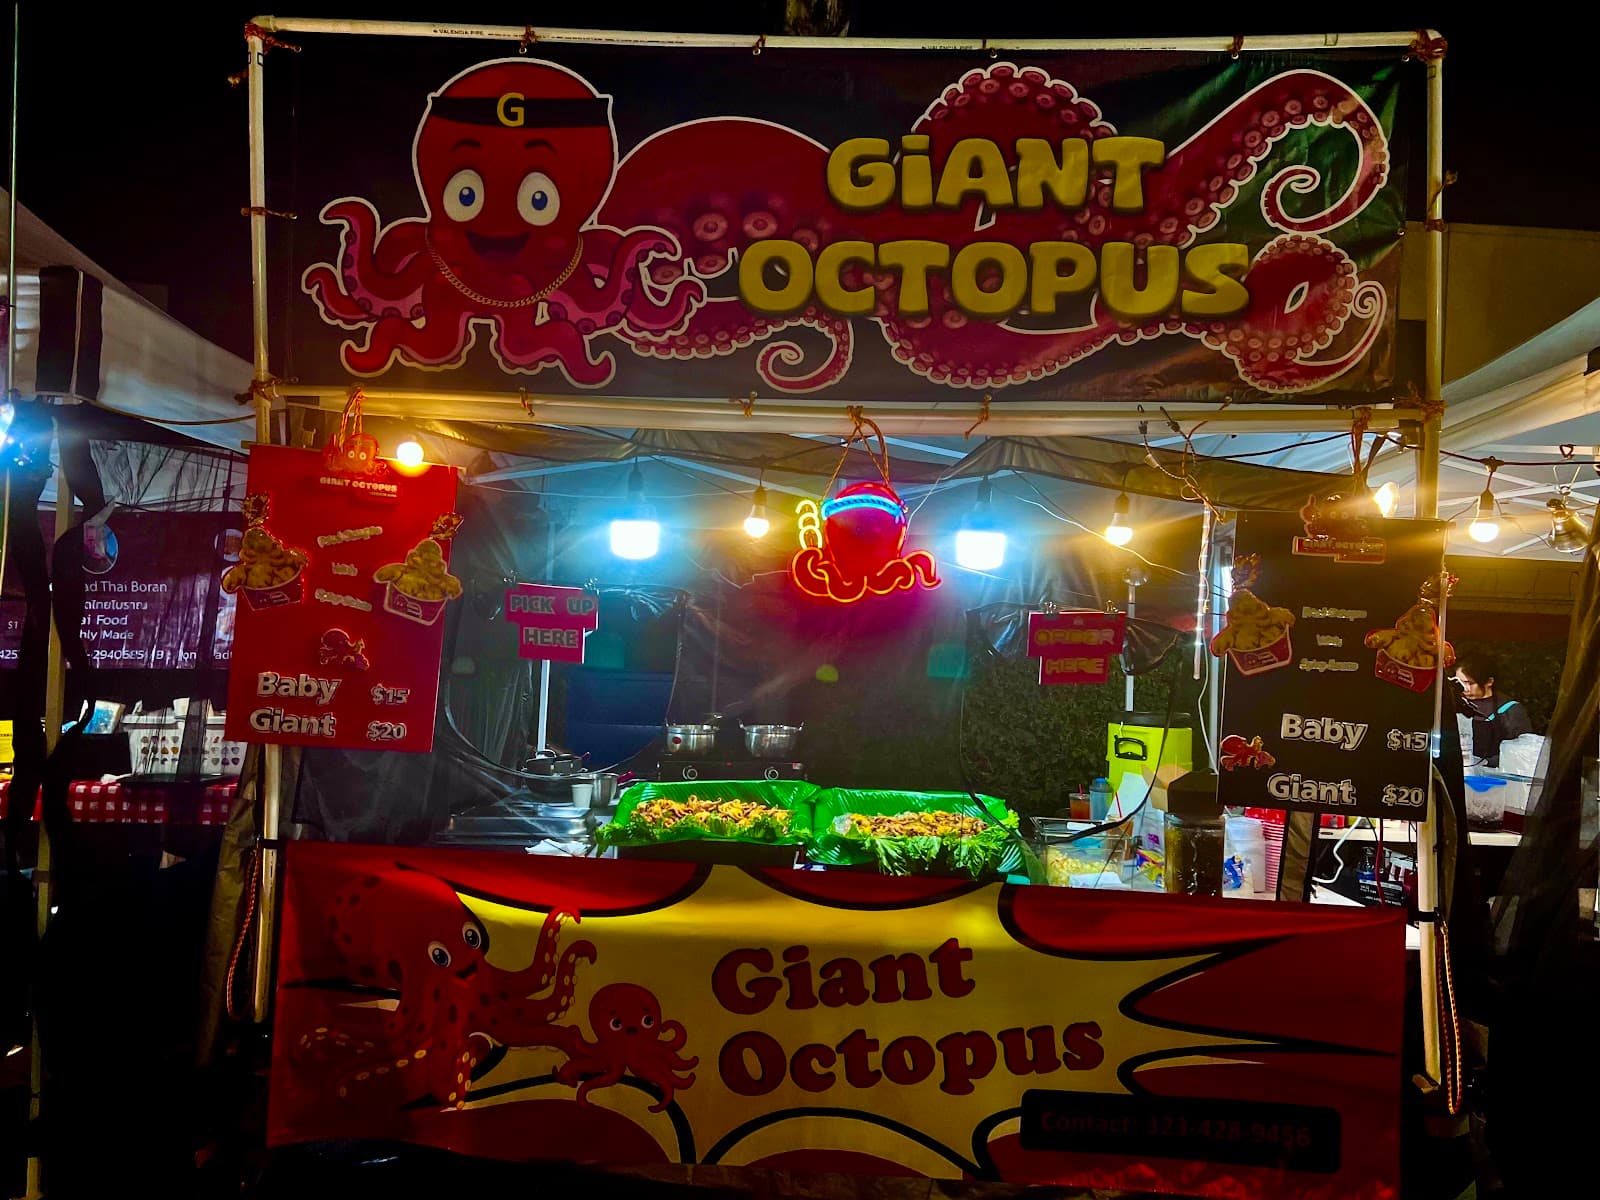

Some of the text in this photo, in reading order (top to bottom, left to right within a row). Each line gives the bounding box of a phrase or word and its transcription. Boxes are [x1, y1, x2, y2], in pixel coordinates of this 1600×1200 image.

[497, 92, 525, 127] G
[738, 239, 1250, 317] OCTOPUS
[101, 581, 127, 593] Thai
[131, 581, 168, 593] Boran
[96, 614, 129, 626] Food
[510, 595, 595, 616] PICK UP
[523, 627, 579, 648] HERE
[1045, 658, 1104, 675] HERE
[257, 671, 410, 705] Baby $15
[250, 707, 407, 741] Giant $20
[1281, 713, 1429, 751] Baby $15
[1267, 773, 1425, 807] Giant $20
[711, 937, 976, 1015] Giant
[718, 1021, 1105, 1096] Octopus
